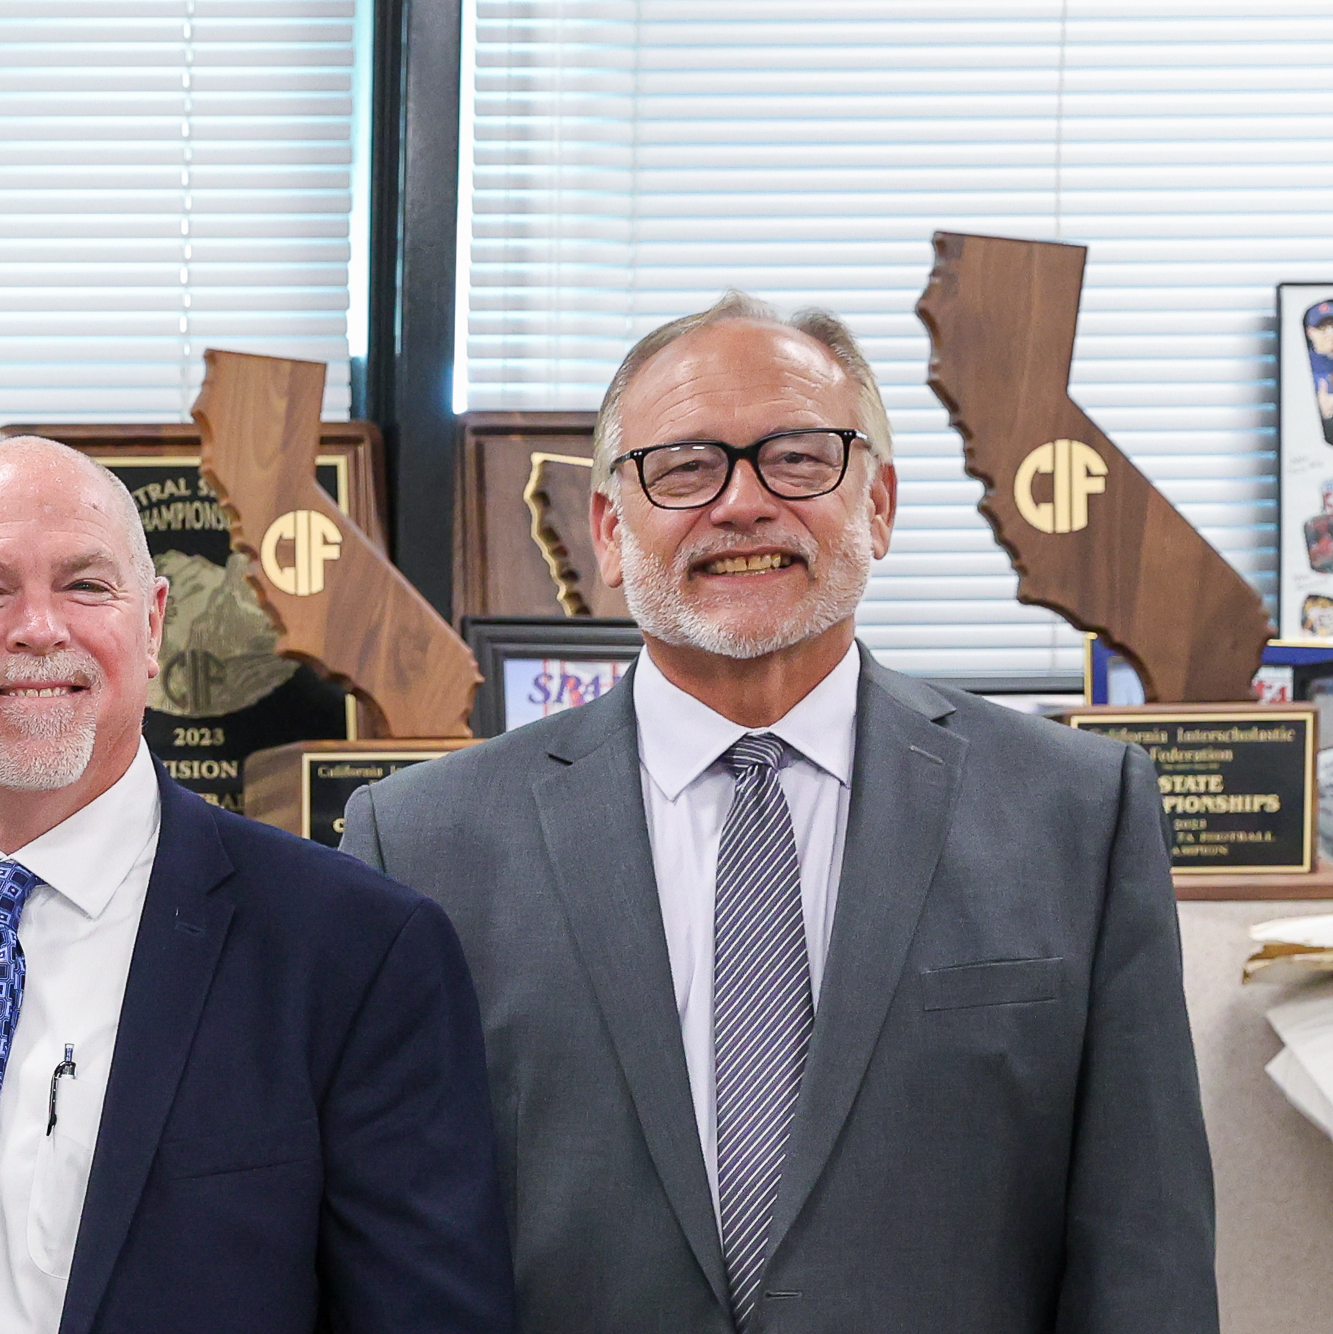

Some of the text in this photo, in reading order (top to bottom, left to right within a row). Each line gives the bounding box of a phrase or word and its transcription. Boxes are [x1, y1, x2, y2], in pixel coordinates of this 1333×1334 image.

[133, 477, 192, 506] TRAL
[1157, 774, 1224, 794] STATE
[1162, 794, 1281, 813] PIONSHIPS
